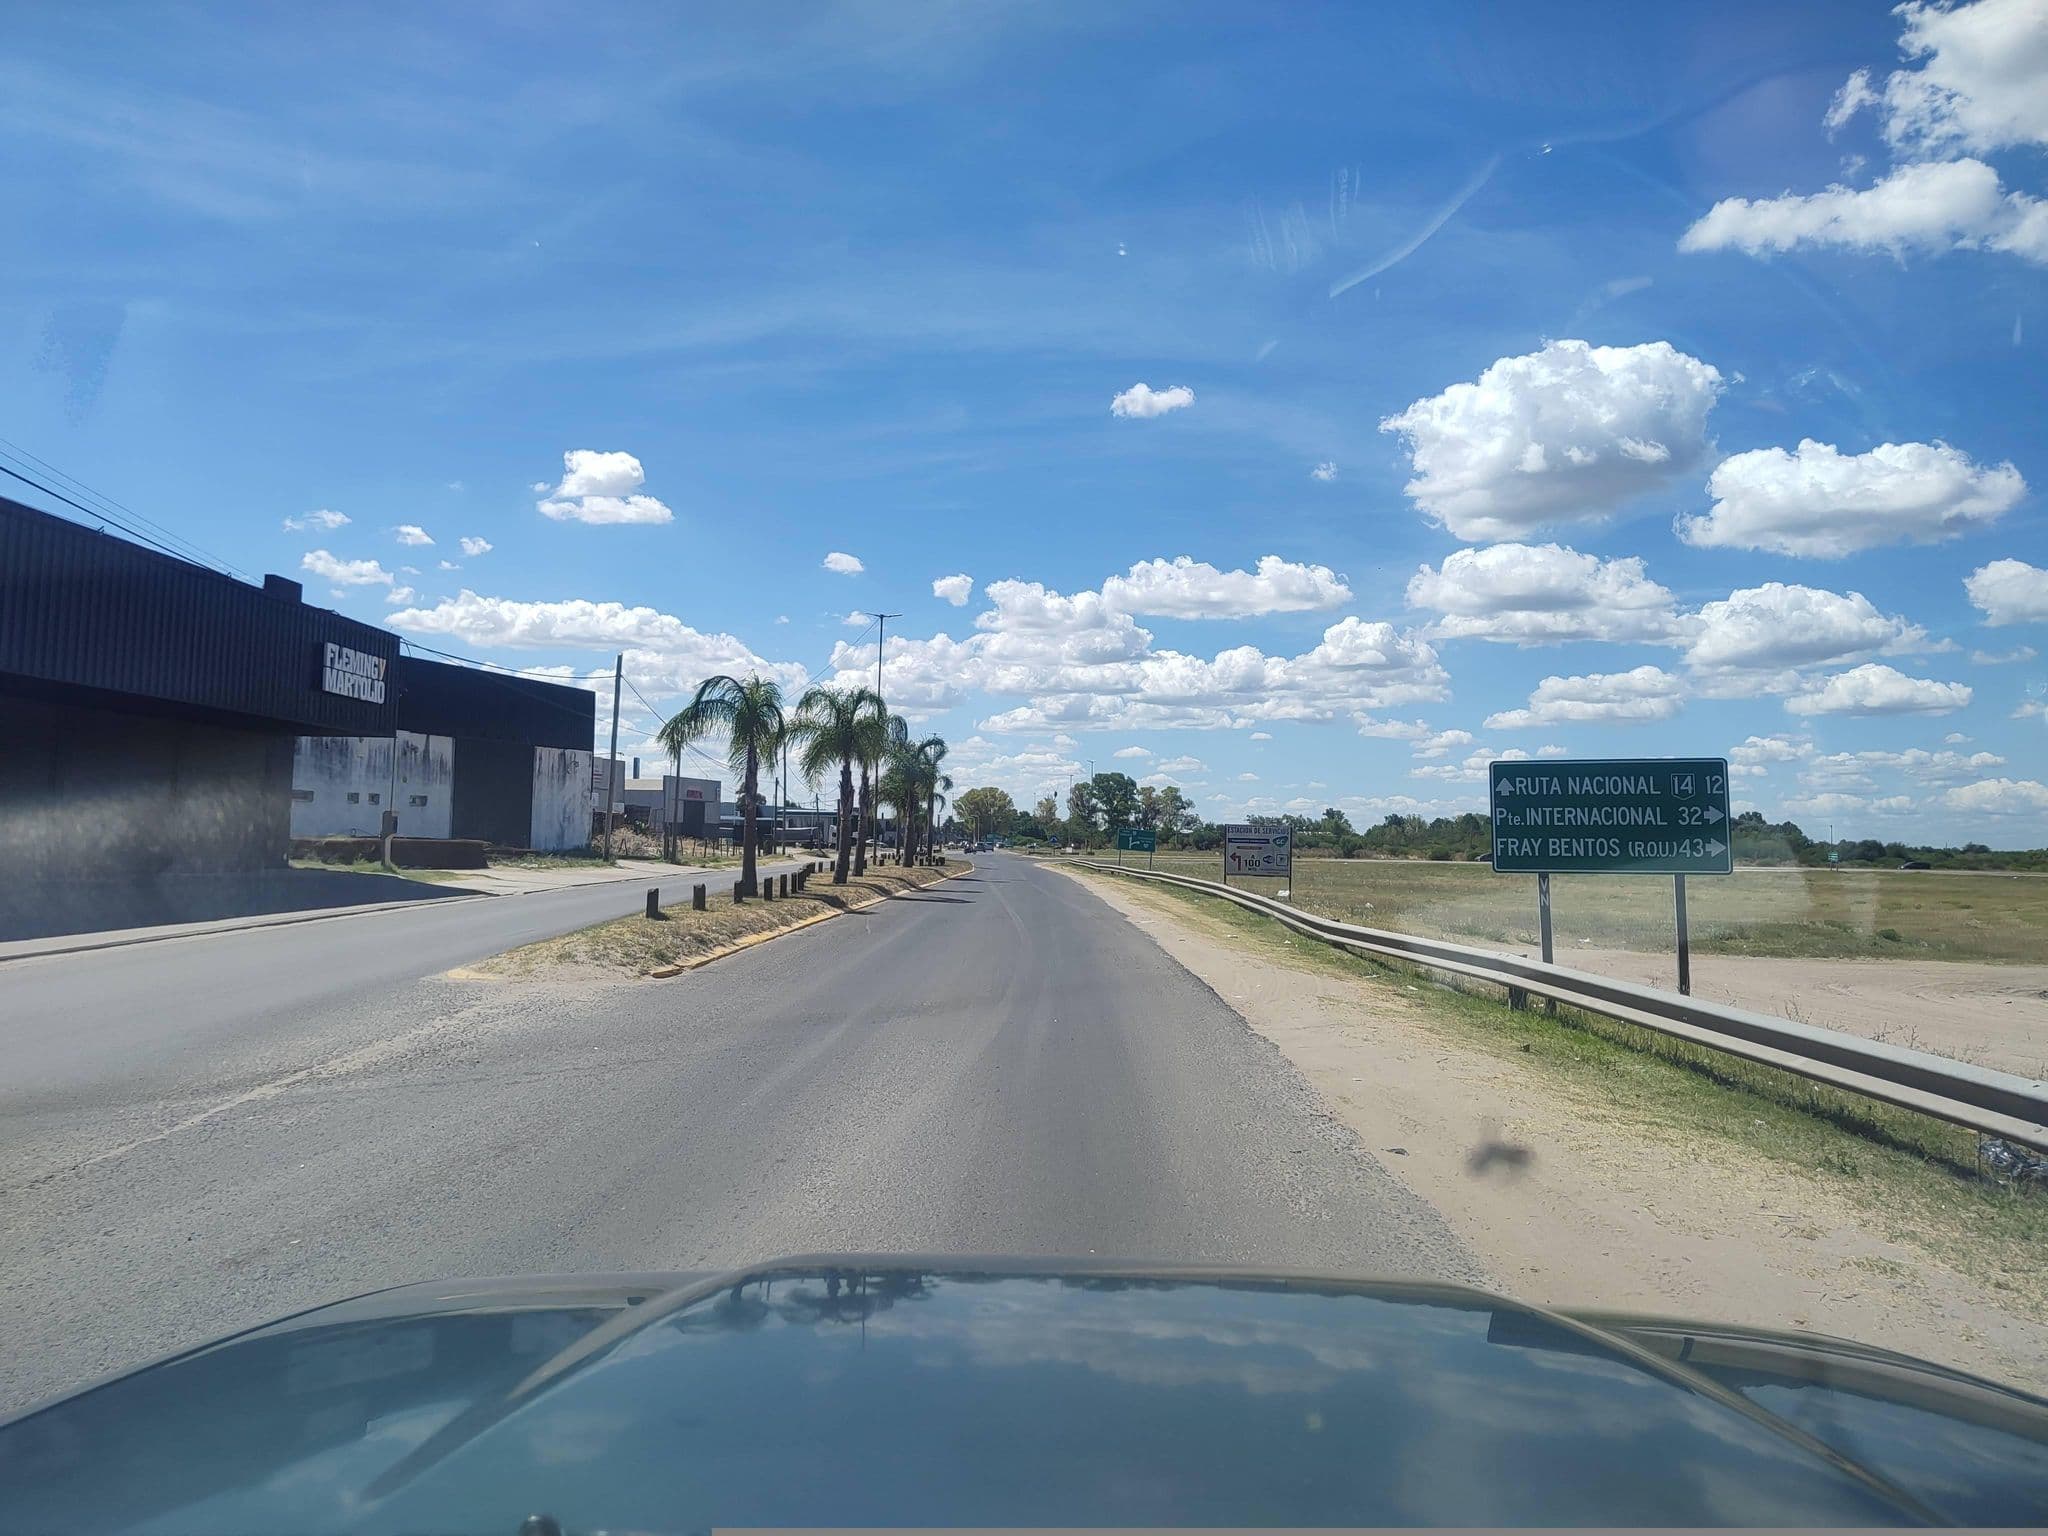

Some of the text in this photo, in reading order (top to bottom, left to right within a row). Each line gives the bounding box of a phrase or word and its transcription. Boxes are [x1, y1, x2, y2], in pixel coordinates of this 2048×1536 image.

[325, 642, 378, 680] FLEMING
[323, 667, 386, 704] MARTOLIO
[1515, 775, 1724, 796] RUTA NACIONAL 14 12
[1496, 807, 1702, 826] Pte. INTERNACIONAL 32
[1496, 838, 1542, 857] FRAY
[1548, 838, 1620, 857] BENTOS
[1679, 838, 1704, 858] 43
[1244, 859, 1261, 867] 100
